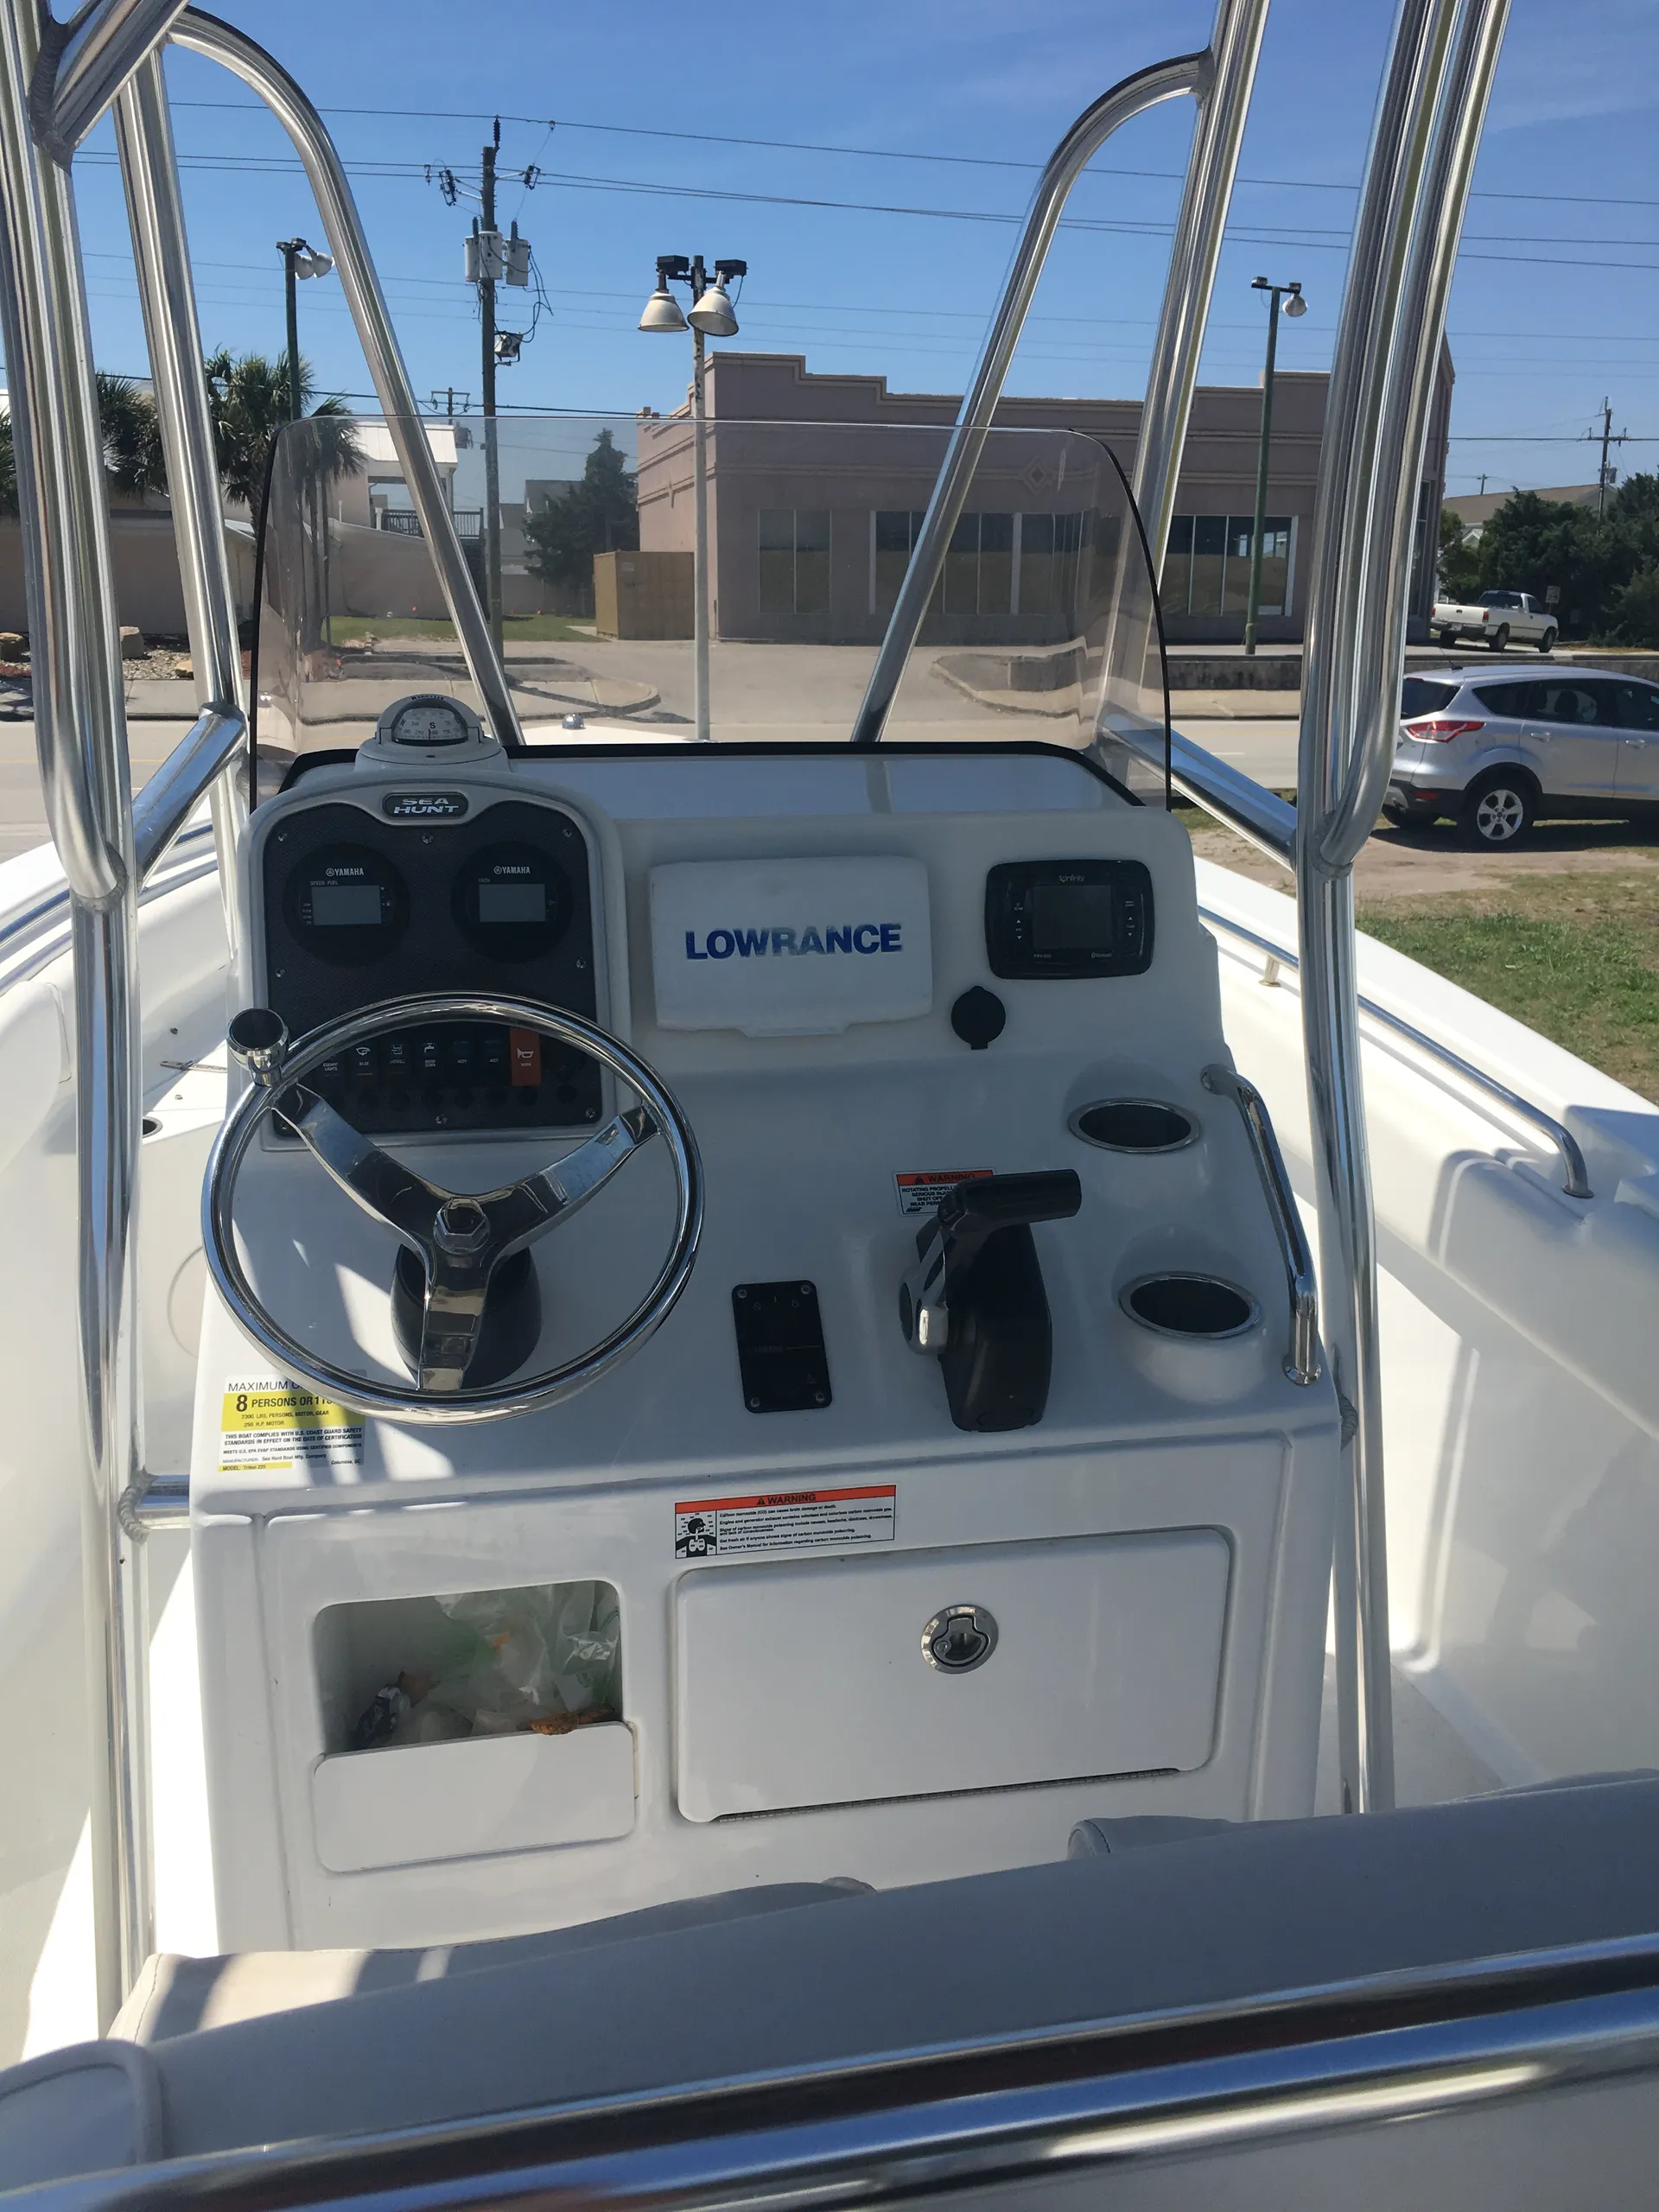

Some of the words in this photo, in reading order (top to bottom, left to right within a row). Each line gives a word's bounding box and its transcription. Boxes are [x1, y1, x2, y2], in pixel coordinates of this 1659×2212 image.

[394, 805, 459, 814] HUNT
[334, 868, 364, 876] YAMAHA
[685, 923, 903, 960] LOWRANCE
[928, 1173, 976, 1183] WARNING
[228, 1381, 288, 1392] MAXIMUM
[236, 1395, 248, 1412] 8
[251, 1397, 296, 1408] PERSONS
[300, 1396, 313, 1406] OR
[767, 1494, 817, 1504] WARNING
